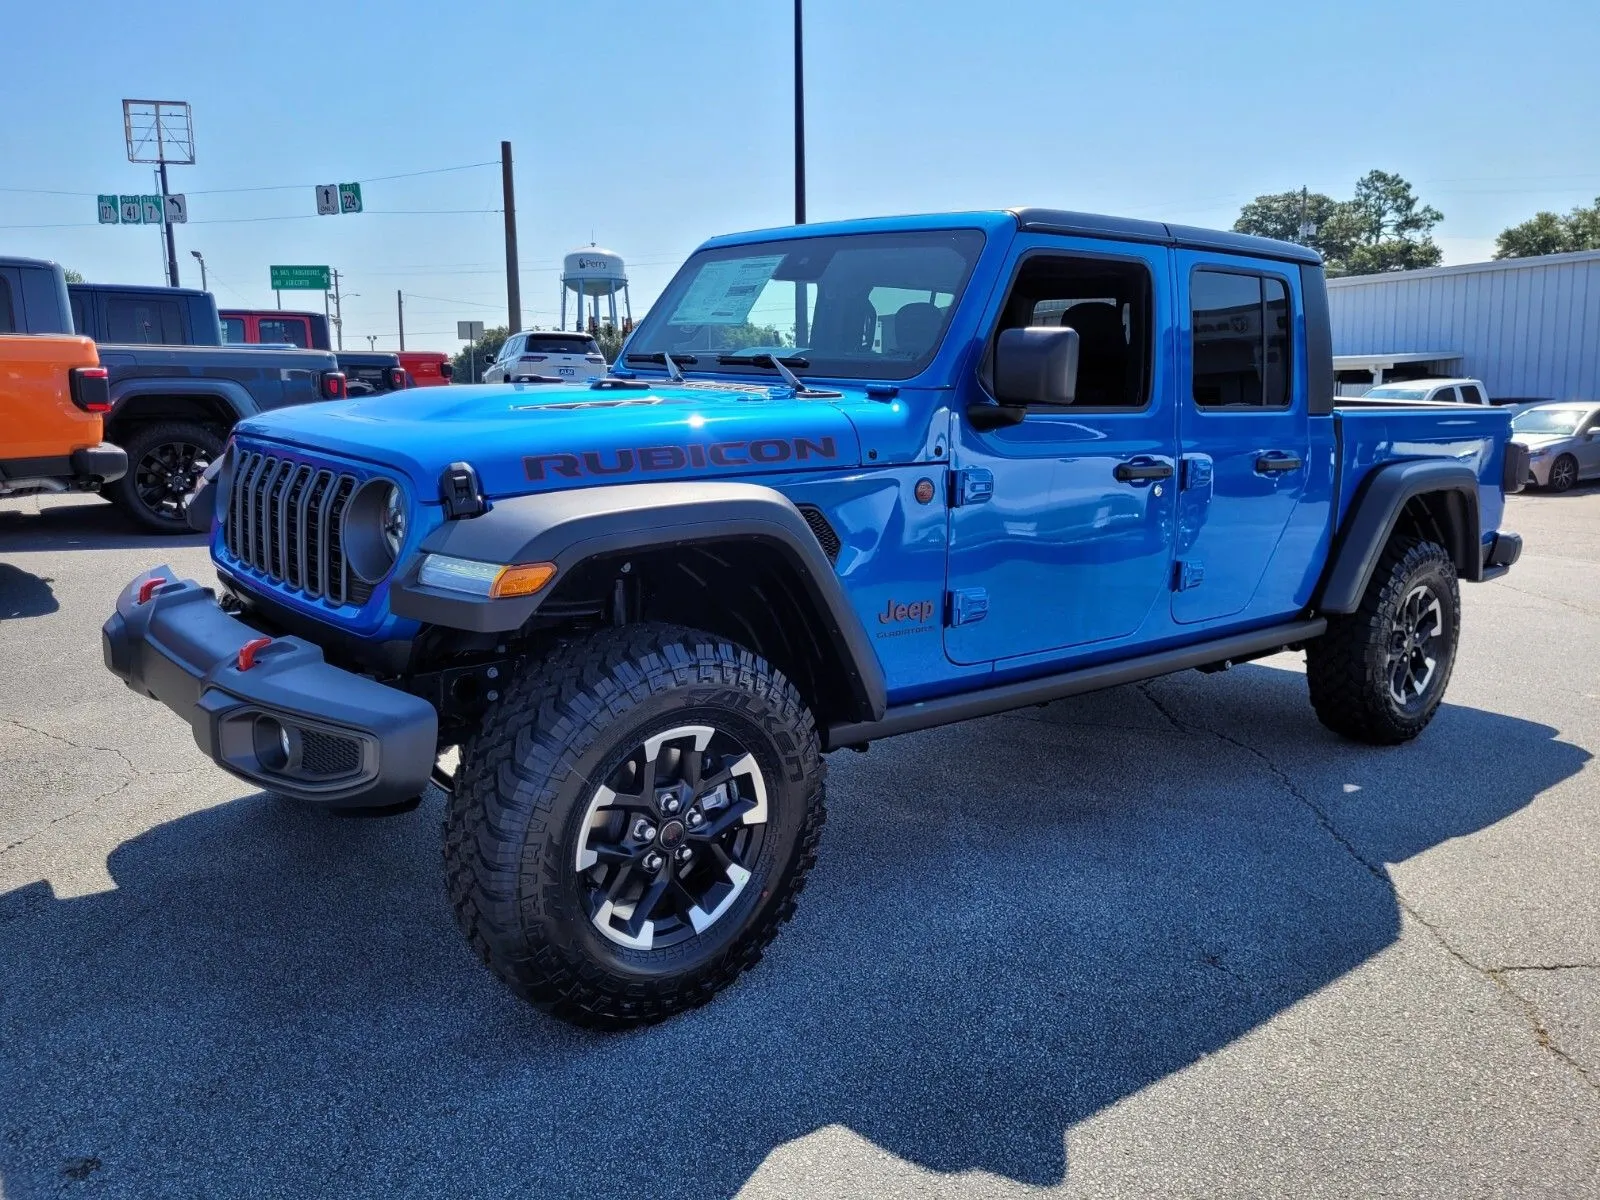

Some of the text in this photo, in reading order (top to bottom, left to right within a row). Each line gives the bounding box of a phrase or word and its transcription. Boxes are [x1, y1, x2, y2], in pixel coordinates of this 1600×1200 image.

[344, 195, 356, 209] 224
[101, 205, 111, 219] 127
[126, 205, 136, 219] 41
[148, 206, 153, 219] 7
[585, 259, 607, 269] Perry
[521, 436, 837, 481] RUBICON
[878, 599, 934, 624] Jeep
